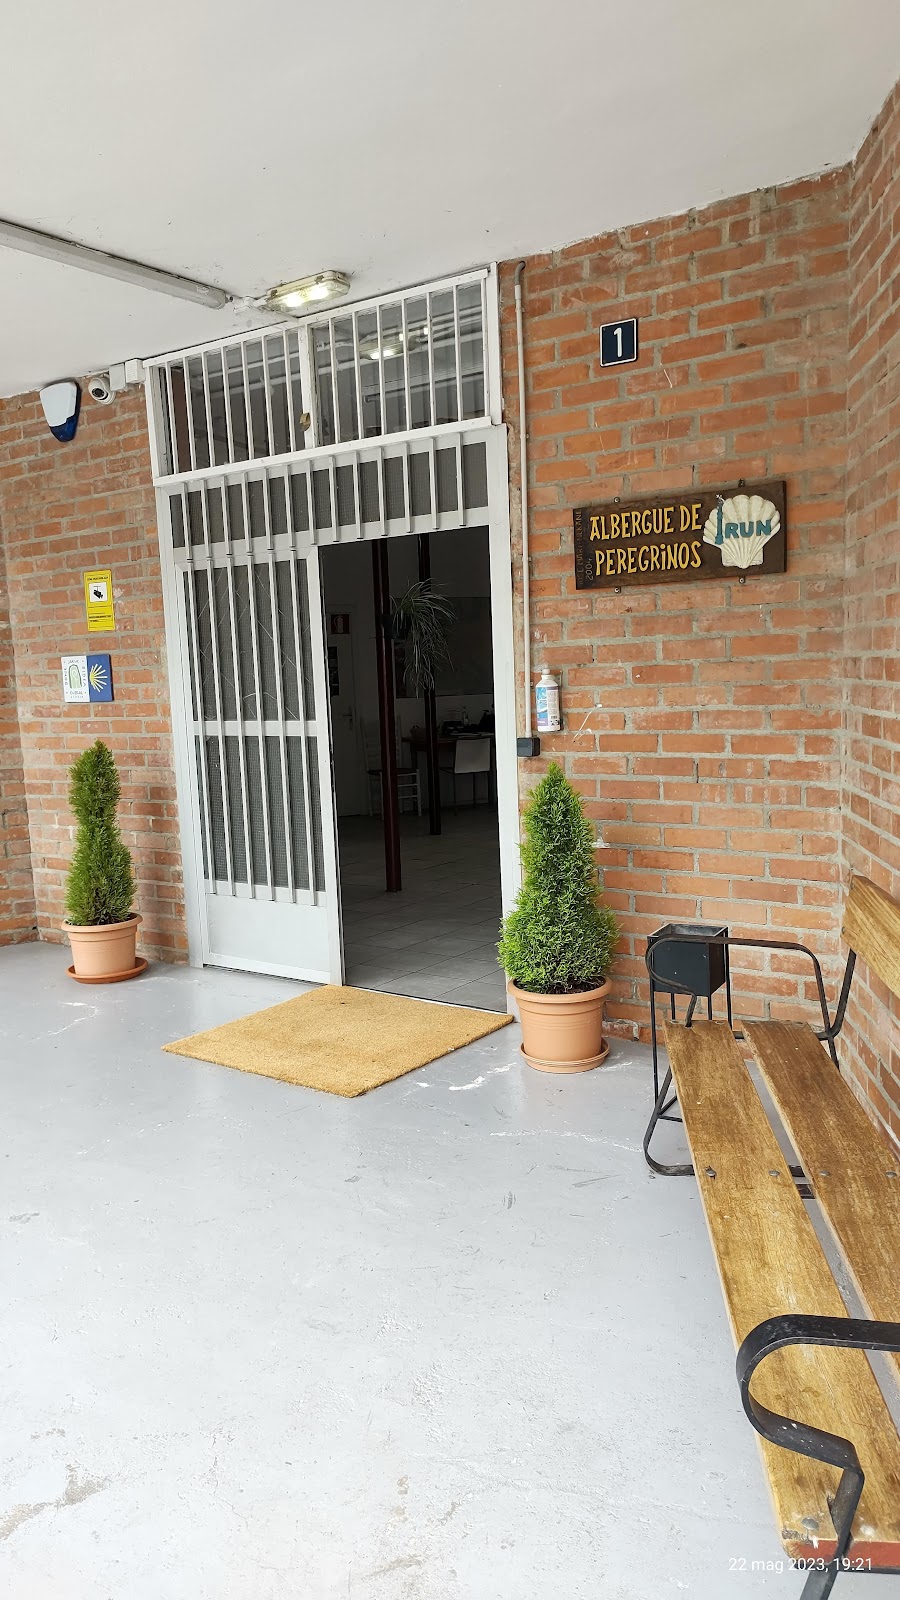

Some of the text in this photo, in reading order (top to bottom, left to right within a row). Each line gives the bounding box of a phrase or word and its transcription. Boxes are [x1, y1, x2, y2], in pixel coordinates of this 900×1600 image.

[613, 327, 622, 358] 1
[589, 503, 703, 541] ALBERGUE DE
